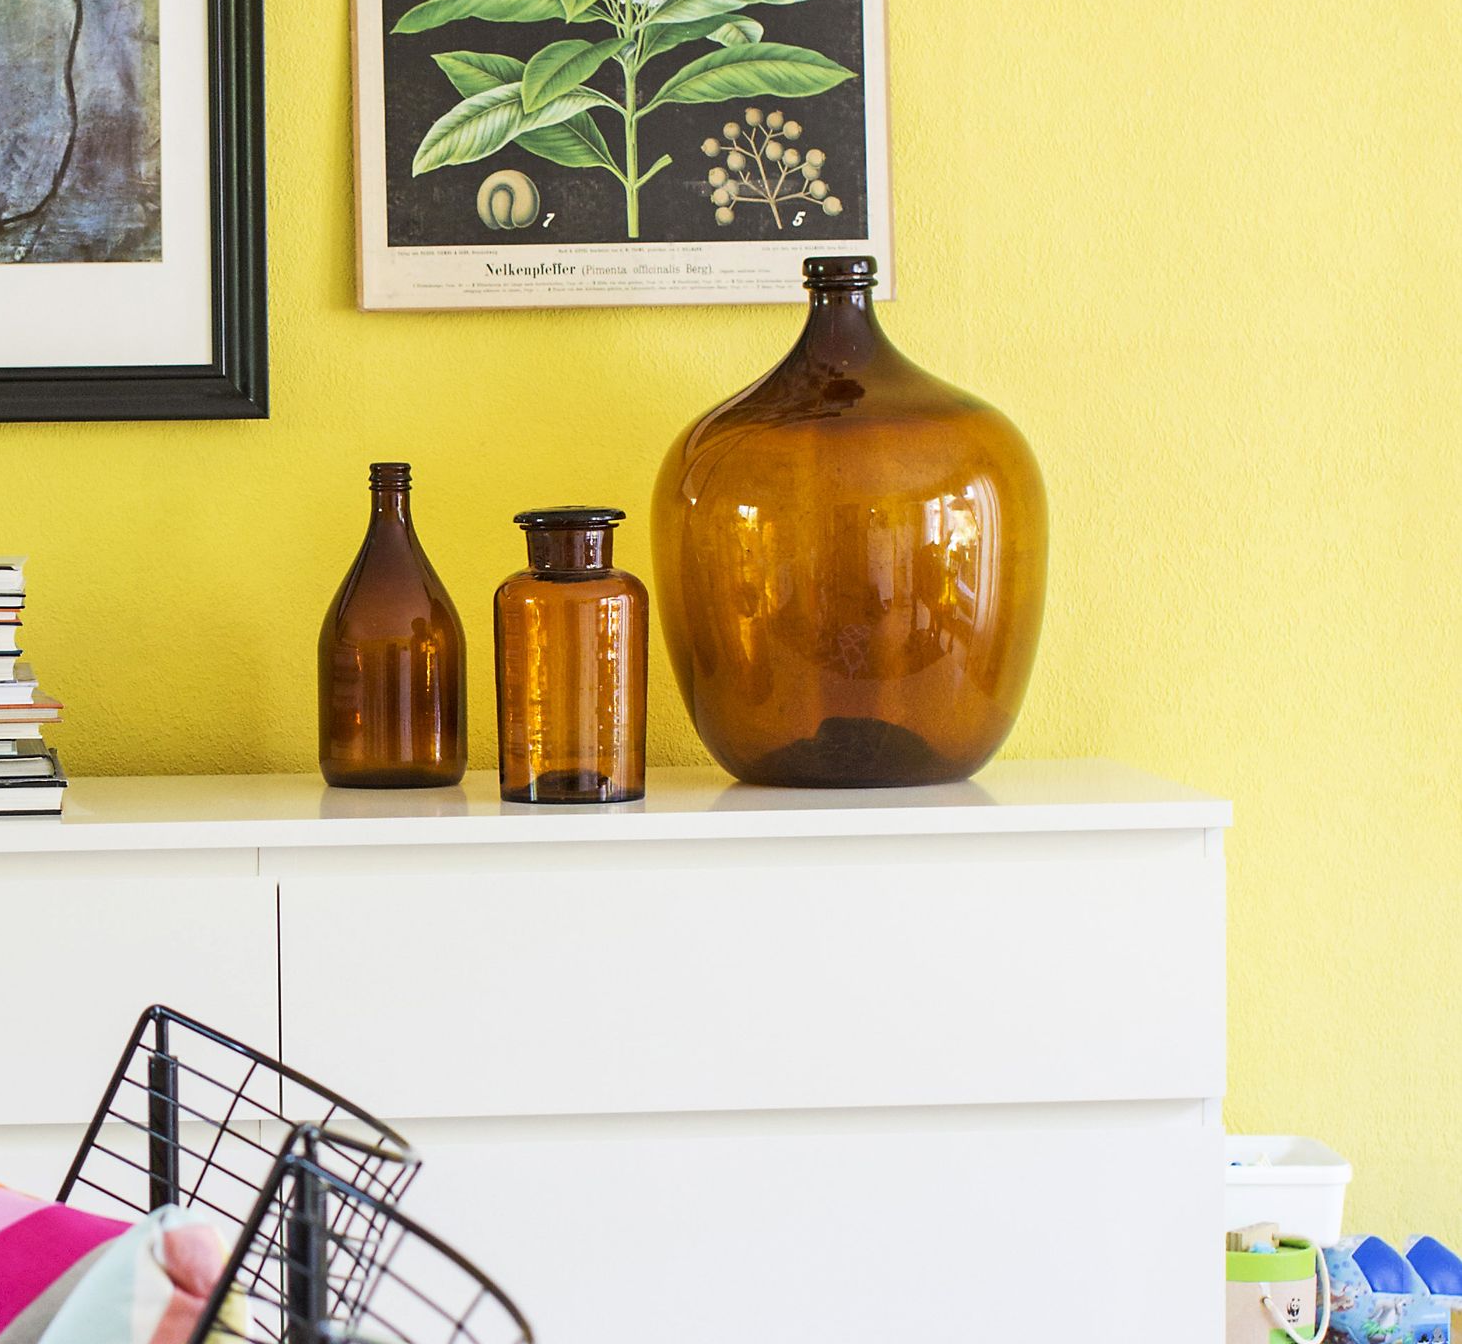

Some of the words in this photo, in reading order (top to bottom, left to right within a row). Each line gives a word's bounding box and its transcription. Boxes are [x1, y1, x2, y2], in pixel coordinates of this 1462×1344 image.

[542, 212, 555, 228] 7
[792, 210, 806, 227] 5
[485, 262, 577, 279] Nelkenpfeffer
[581, 264, 628, 277] (Pimenta
[633, 264, 681, 275] officinalis
